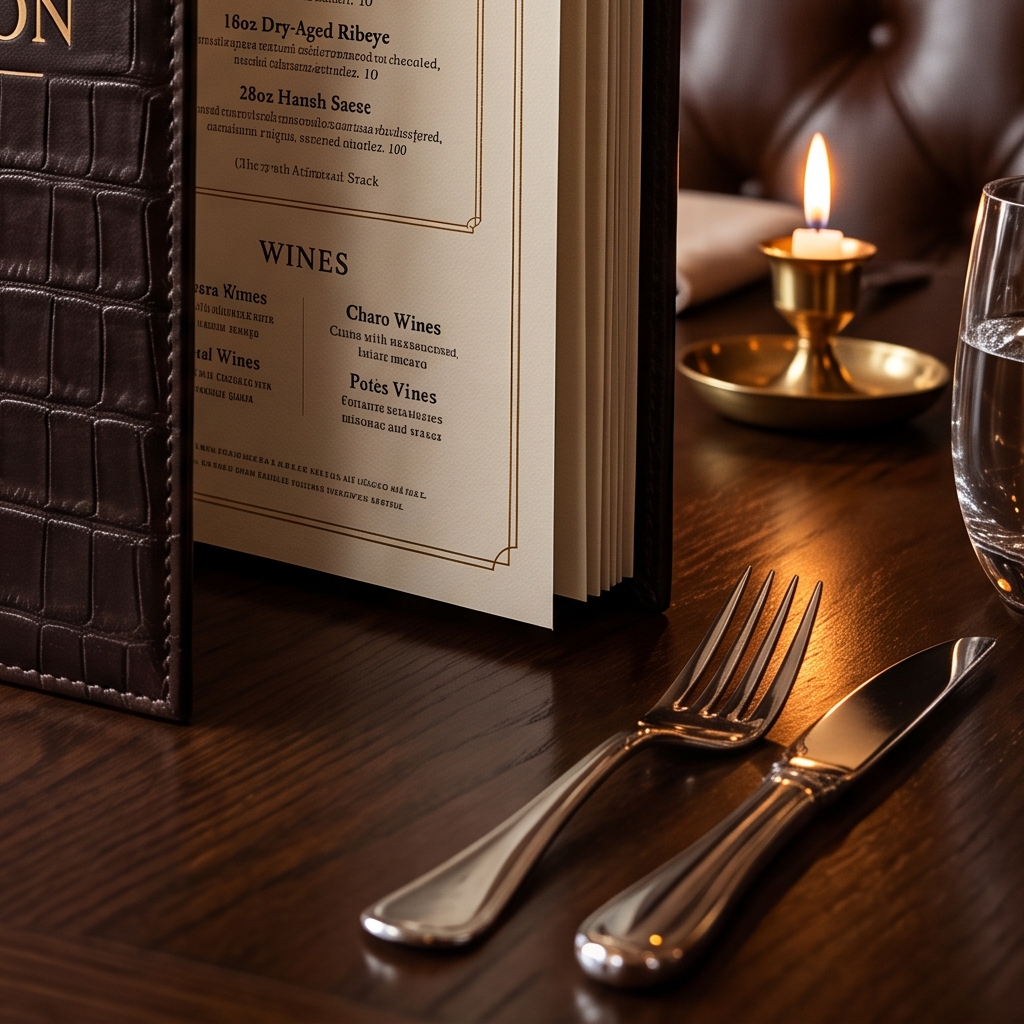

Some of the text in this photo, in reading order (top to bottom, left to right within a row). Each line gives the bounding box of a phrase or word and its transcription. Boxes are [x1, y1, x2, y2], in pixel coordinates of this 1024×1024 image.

[224, 14, 390, 49] 18oz Dry-Aged Ribeye
[364, 68, 379, 80] 10
[239, 85, 372, 115] 28oz Hansh Saese
[389, 143, 407, 156] 100
[259, 239, 349, 276] WINES
[346, 304, 442, 335] Charo Wines
[216, 348, 260, 371] Wines
[393, 381, 437, 404] Vines
